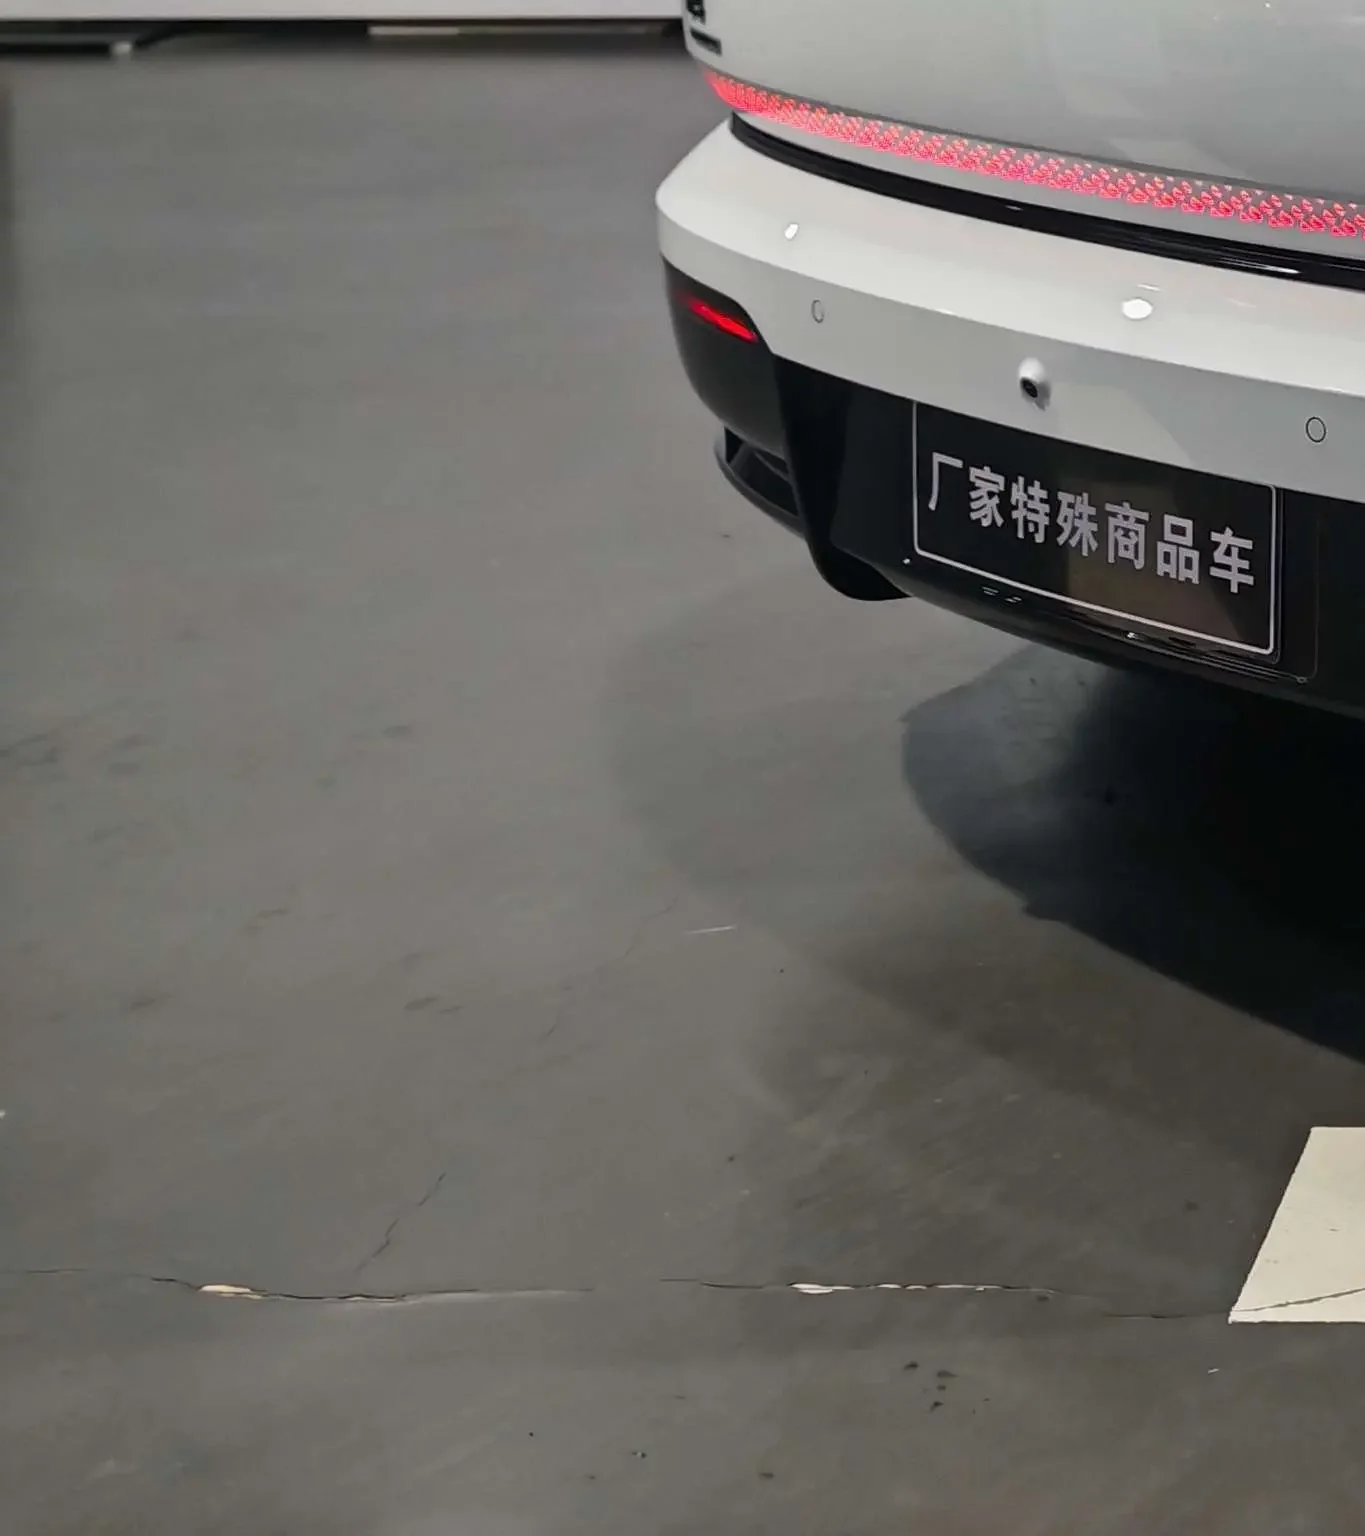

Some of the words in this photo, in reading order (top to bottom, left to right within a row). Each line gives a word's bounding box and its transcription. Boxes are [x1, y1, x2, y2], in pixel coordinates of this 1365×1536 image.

[926, 451, 1256, 594] 厂家特殊商品车
